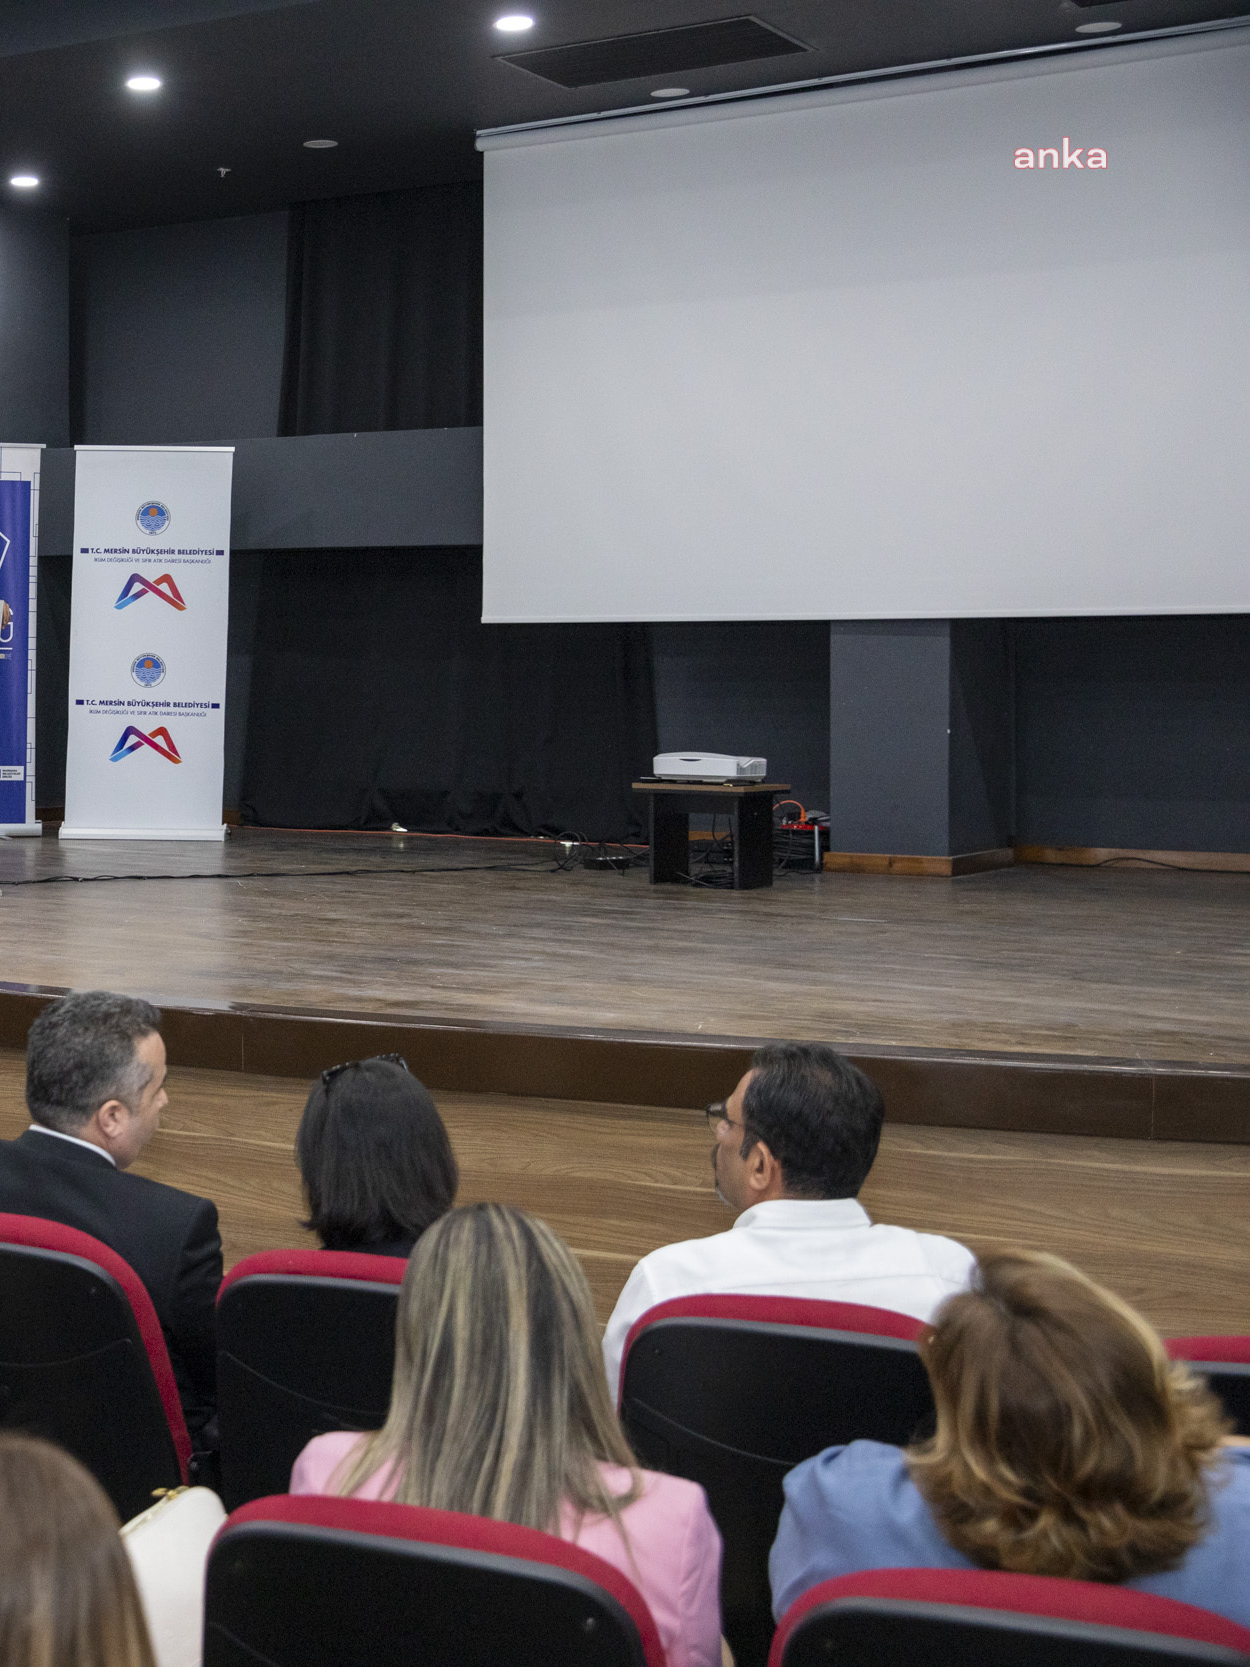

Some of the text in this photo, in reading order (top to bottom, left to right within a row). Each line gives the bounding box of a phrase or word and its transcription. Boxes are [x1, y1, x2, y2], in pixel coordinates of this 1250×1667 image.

[103, 547, 130, 555] MERSİN
[131, 547, 176, 557] BÜYÜKŞEHİR
[177, 548, 215, 556] BELEDİYESİ
[98, 699, 125, 707] MERSİN
[126, 699, 171, 709] BÜYÜKŞEHİR
[172, 700, 210, 709] BELEDİYESİ
